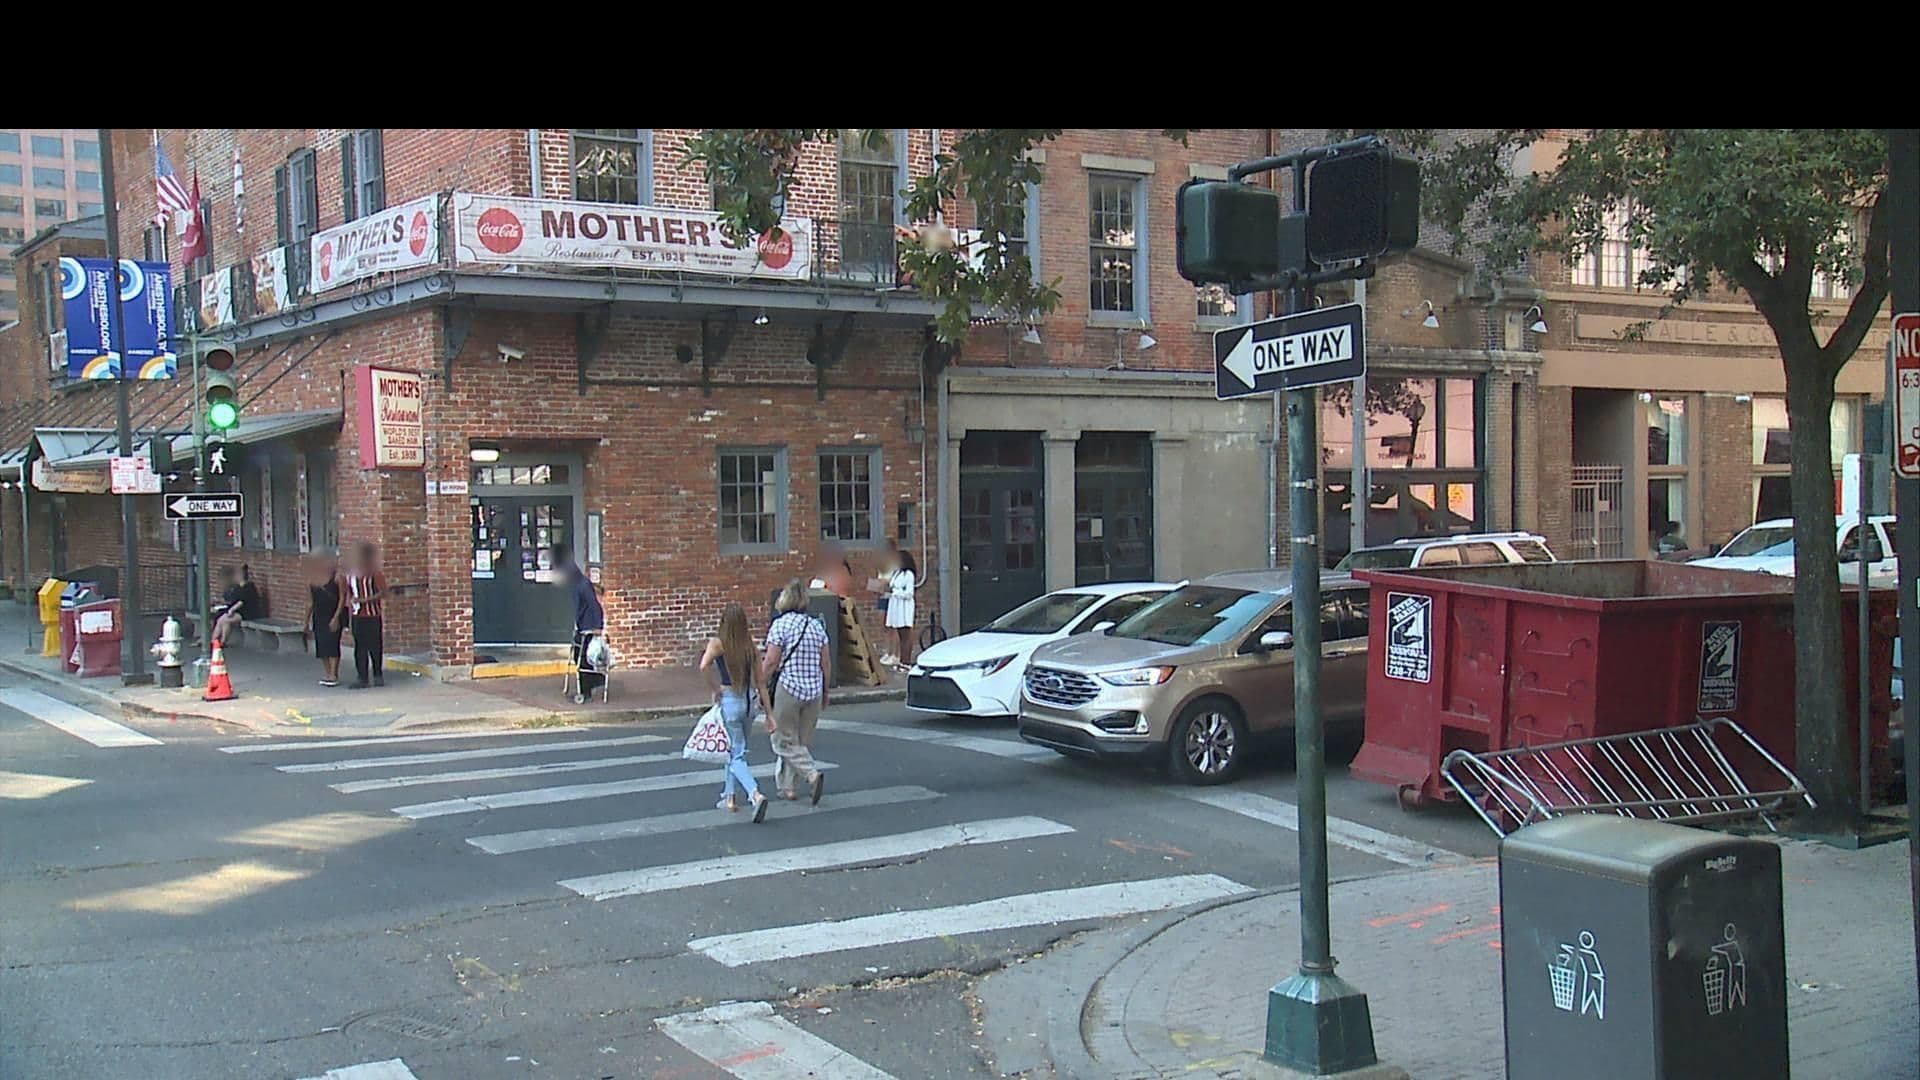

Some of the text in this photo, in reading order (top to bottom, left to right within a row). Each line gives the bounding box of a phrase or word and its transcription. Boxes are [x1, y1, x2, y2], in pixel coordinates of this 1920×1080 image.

[541, 209, 738, 249] MOTHER'S
[541, 241, 621, 259] Restaurant
[632, 250, 656, 261] EST.
[1254, 329, 1345, 371] ONE WAY
[380, 378, 420, 399] MOTHER'S
[188, 500, 234, 511] ONE WAY
